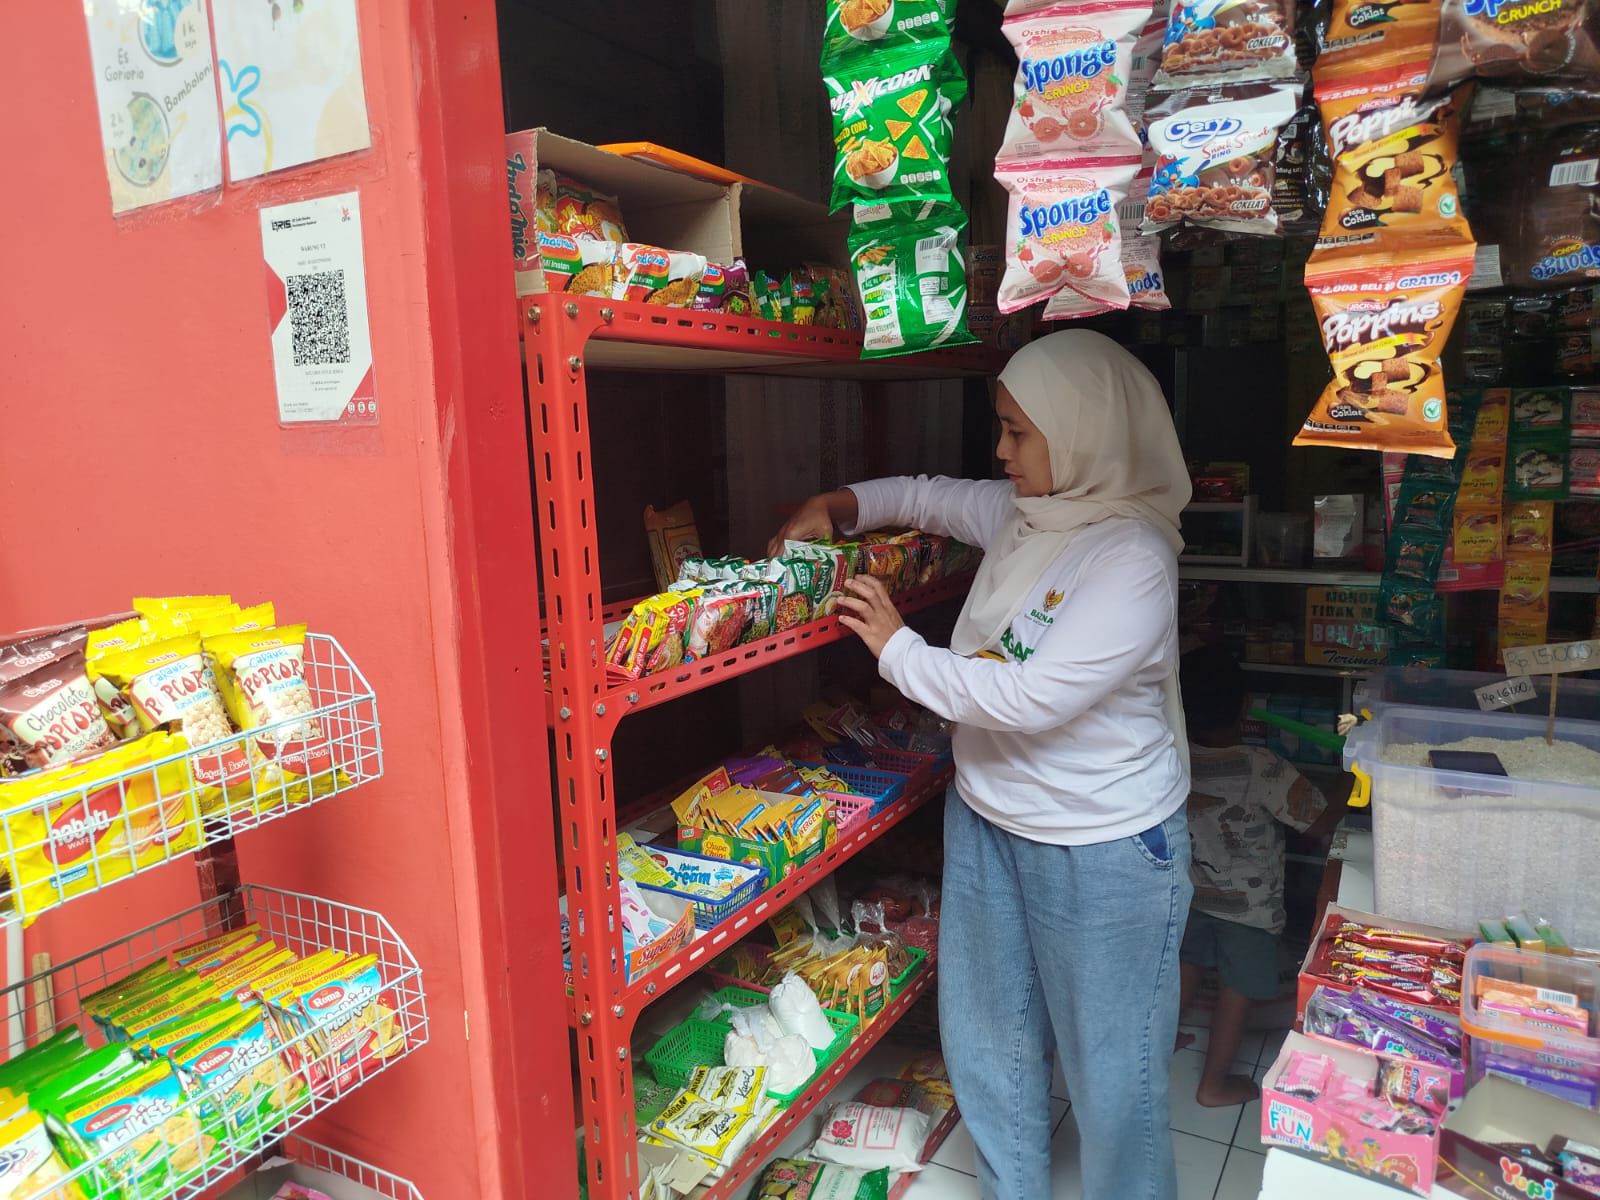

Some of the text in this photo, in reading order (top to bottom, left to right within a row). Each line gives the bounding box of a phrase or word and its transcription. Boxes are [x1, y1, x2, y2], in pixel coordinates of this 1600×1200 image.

[1350, 8, 1385, 27] Coklat
[1497, 0, 1562, 24] CRUNCH
[1021, 39, 1118, 94] Sponge
[1044, 80, 1089, 101] CRUNCH
[1164, 118, 1243, 148] Gery
[1019, 189, 1111, 238] Sponge
[1231, 199, 1265, 212] COKELAT
[1342, 211, 1377, 228] Coklat
[1042, 227, 1088, 245] CRUNCH
[1399, 273, 1448, 289] GRATIS
[1323, 300, 1441, 352] Poppins
[1030, 609, 1054, 625] BAZNA
[26, 687, 92, 733] Chocolate
[312, 990, 341, 1008] Roma
[198, 1050, 231, 1072] Roma
[90, 1106, 130, 1131] Roma
[98, 1098, 173, 1152] Malkist
[1270, 1109, 1312, 1142] FUN
[1500, 1157, 1555, 1200] Yupi
